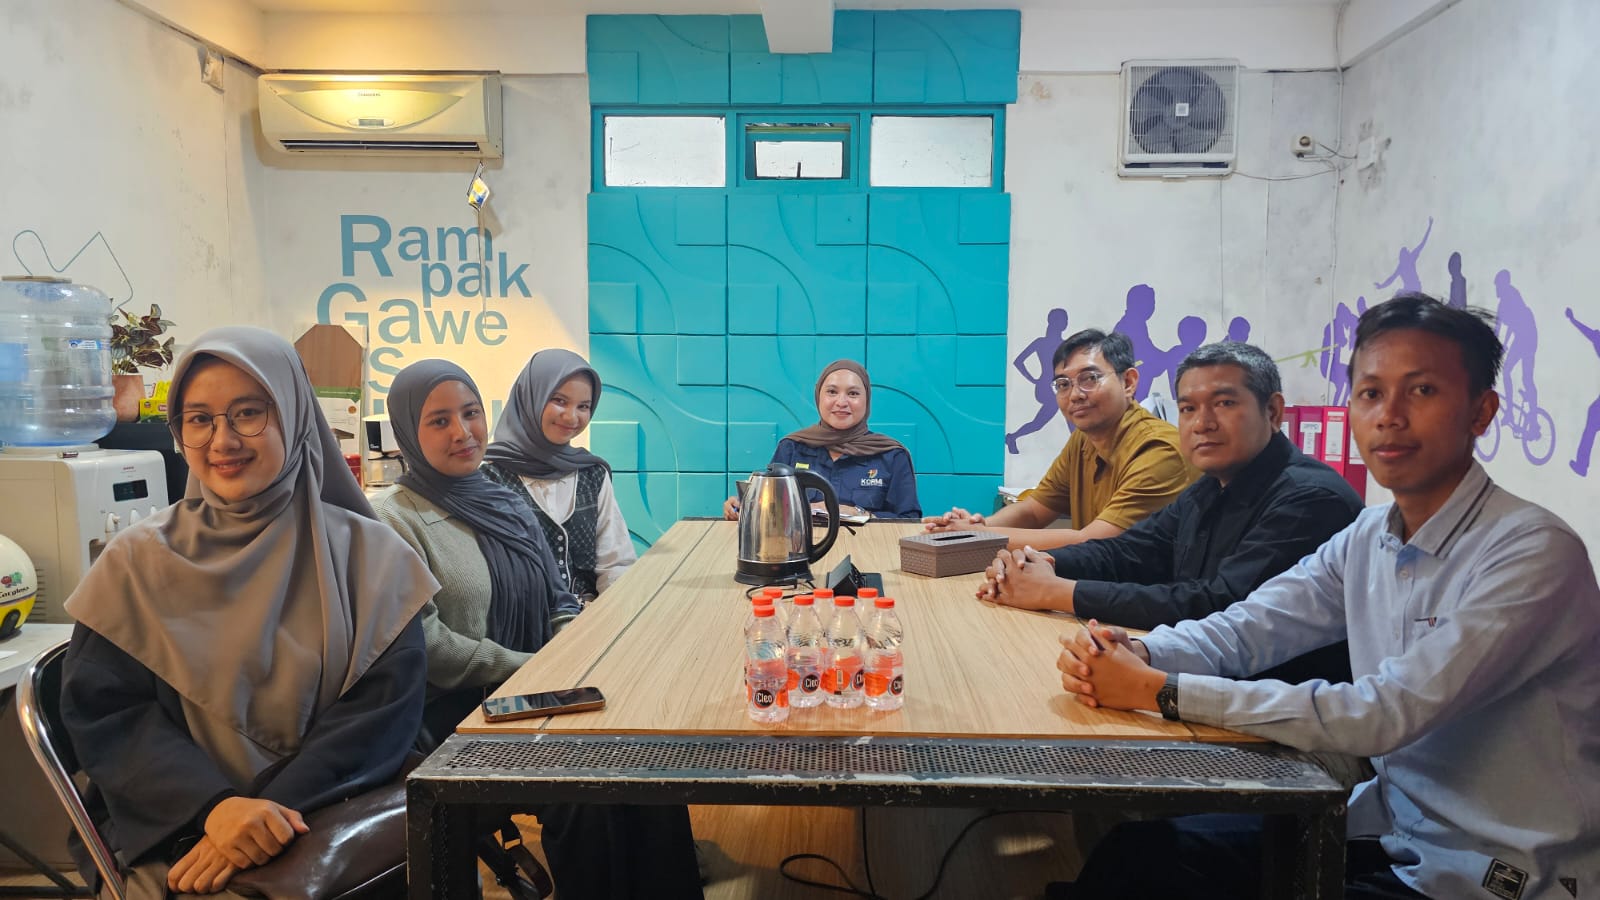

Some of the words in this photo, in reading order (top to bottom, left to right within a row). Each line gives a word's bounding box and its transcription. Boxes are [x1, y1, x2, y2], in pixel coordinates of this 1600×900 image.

[340, 214, 493, 277] Ram
[421, 251, 532, 308] pak
[317, 283, 508, 345] Gawe
[755, 692, 773, 703] Cleo
[805, 678, 818, 688] Cleo
